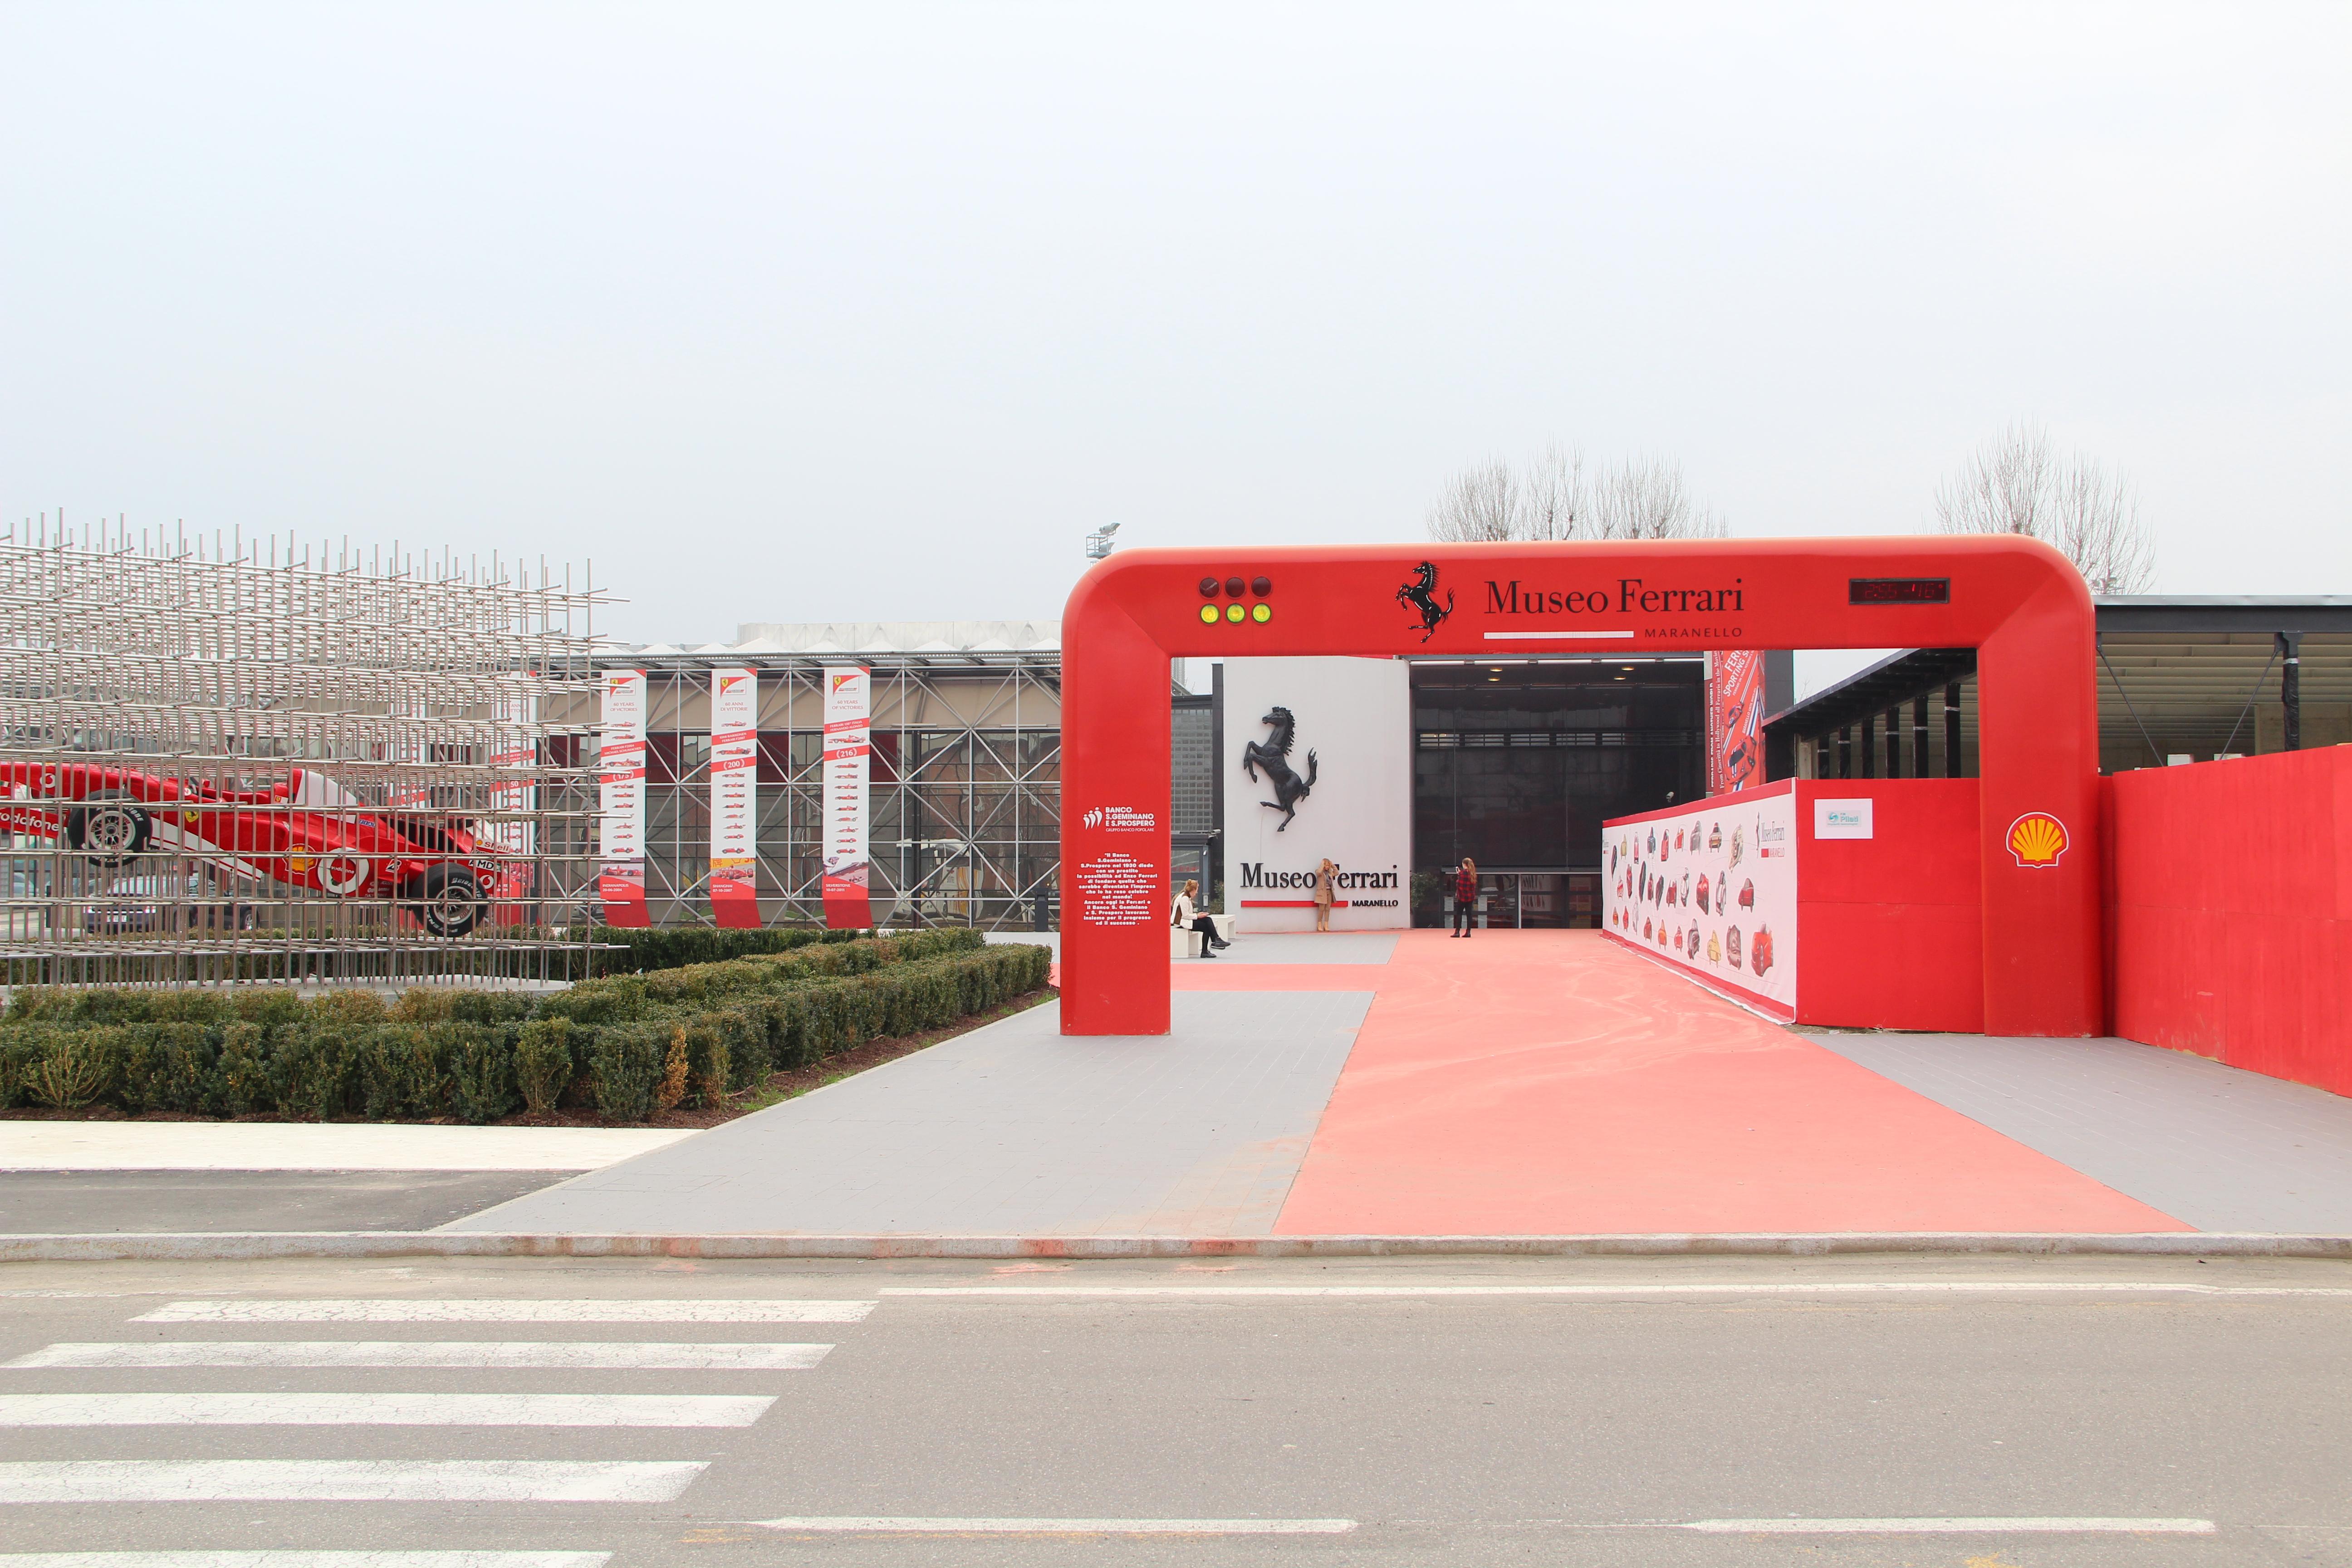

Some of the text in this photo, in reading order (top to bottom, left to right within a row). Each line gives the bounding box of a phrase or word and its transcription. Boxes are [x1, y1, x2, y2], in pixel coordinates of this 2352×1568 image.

[1484, 578, 1744, 613] Museo Ferrari
[1645, 627, 1742, 638] MARANELLO
[1723, 658, 1745, 697] SPORTING
[836, 748, 857, 759] (216)
[723, 759, 745, 770] (200)
[0, 812, 59, 832] odafone
[1761, 820, 1784, 842] Museo Ferrari
[1769, 847, 1785, 858] MARANELLO
[330, 866, 355, 874] vodaone
[1240, 862, 1399, 888] Museo errari
